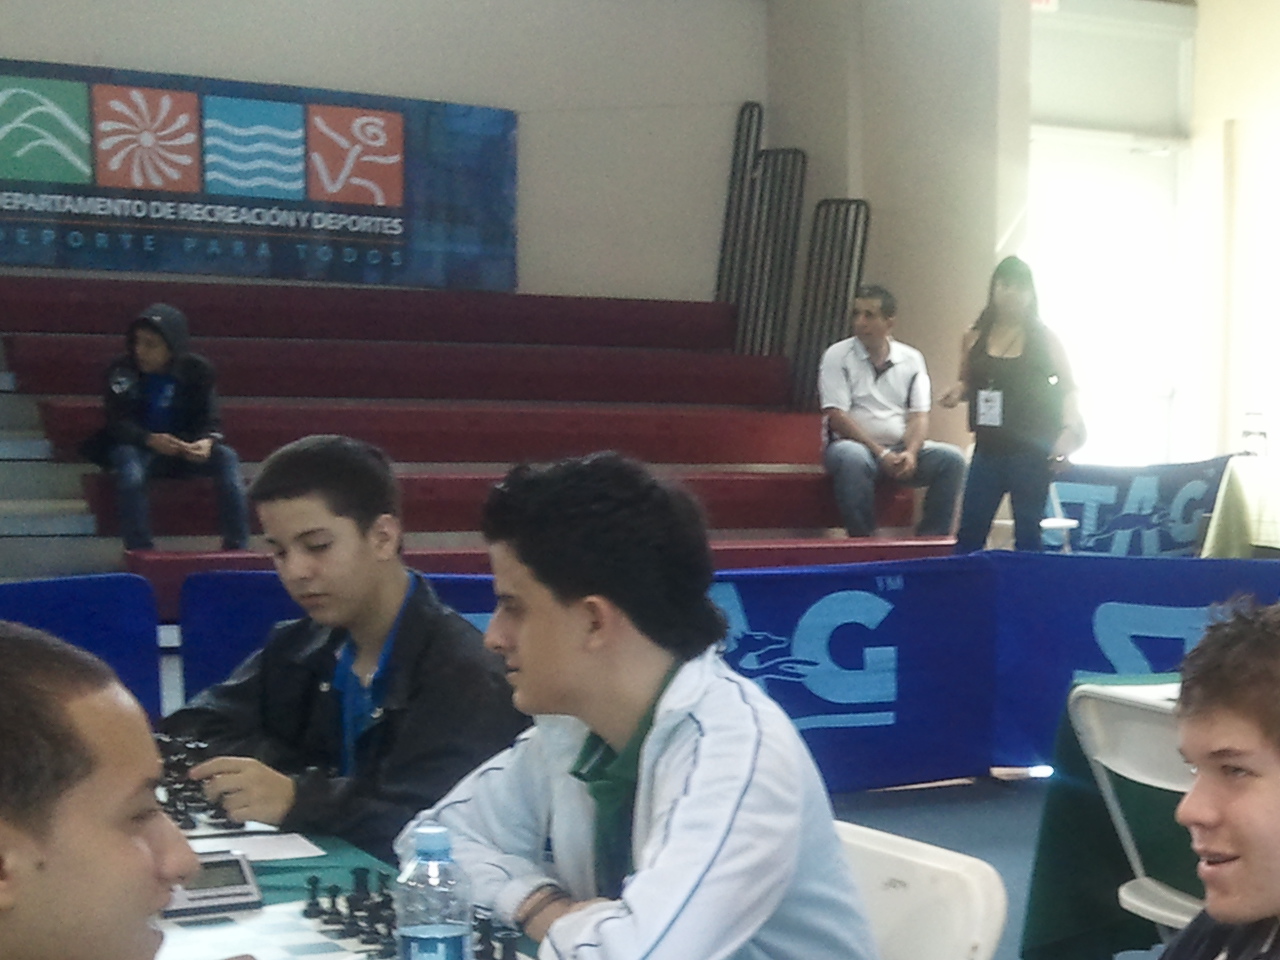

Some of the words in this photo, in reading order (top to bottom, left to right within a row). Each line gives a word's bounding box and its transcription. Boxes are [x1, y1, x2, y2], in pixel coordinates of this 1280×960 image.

[150, 202, 178, 218] DE
[311, 211, 404, 235] DEPORTES
[184, 237, 271, 258] PARA
[296, 244, 402, 266] TODOS
